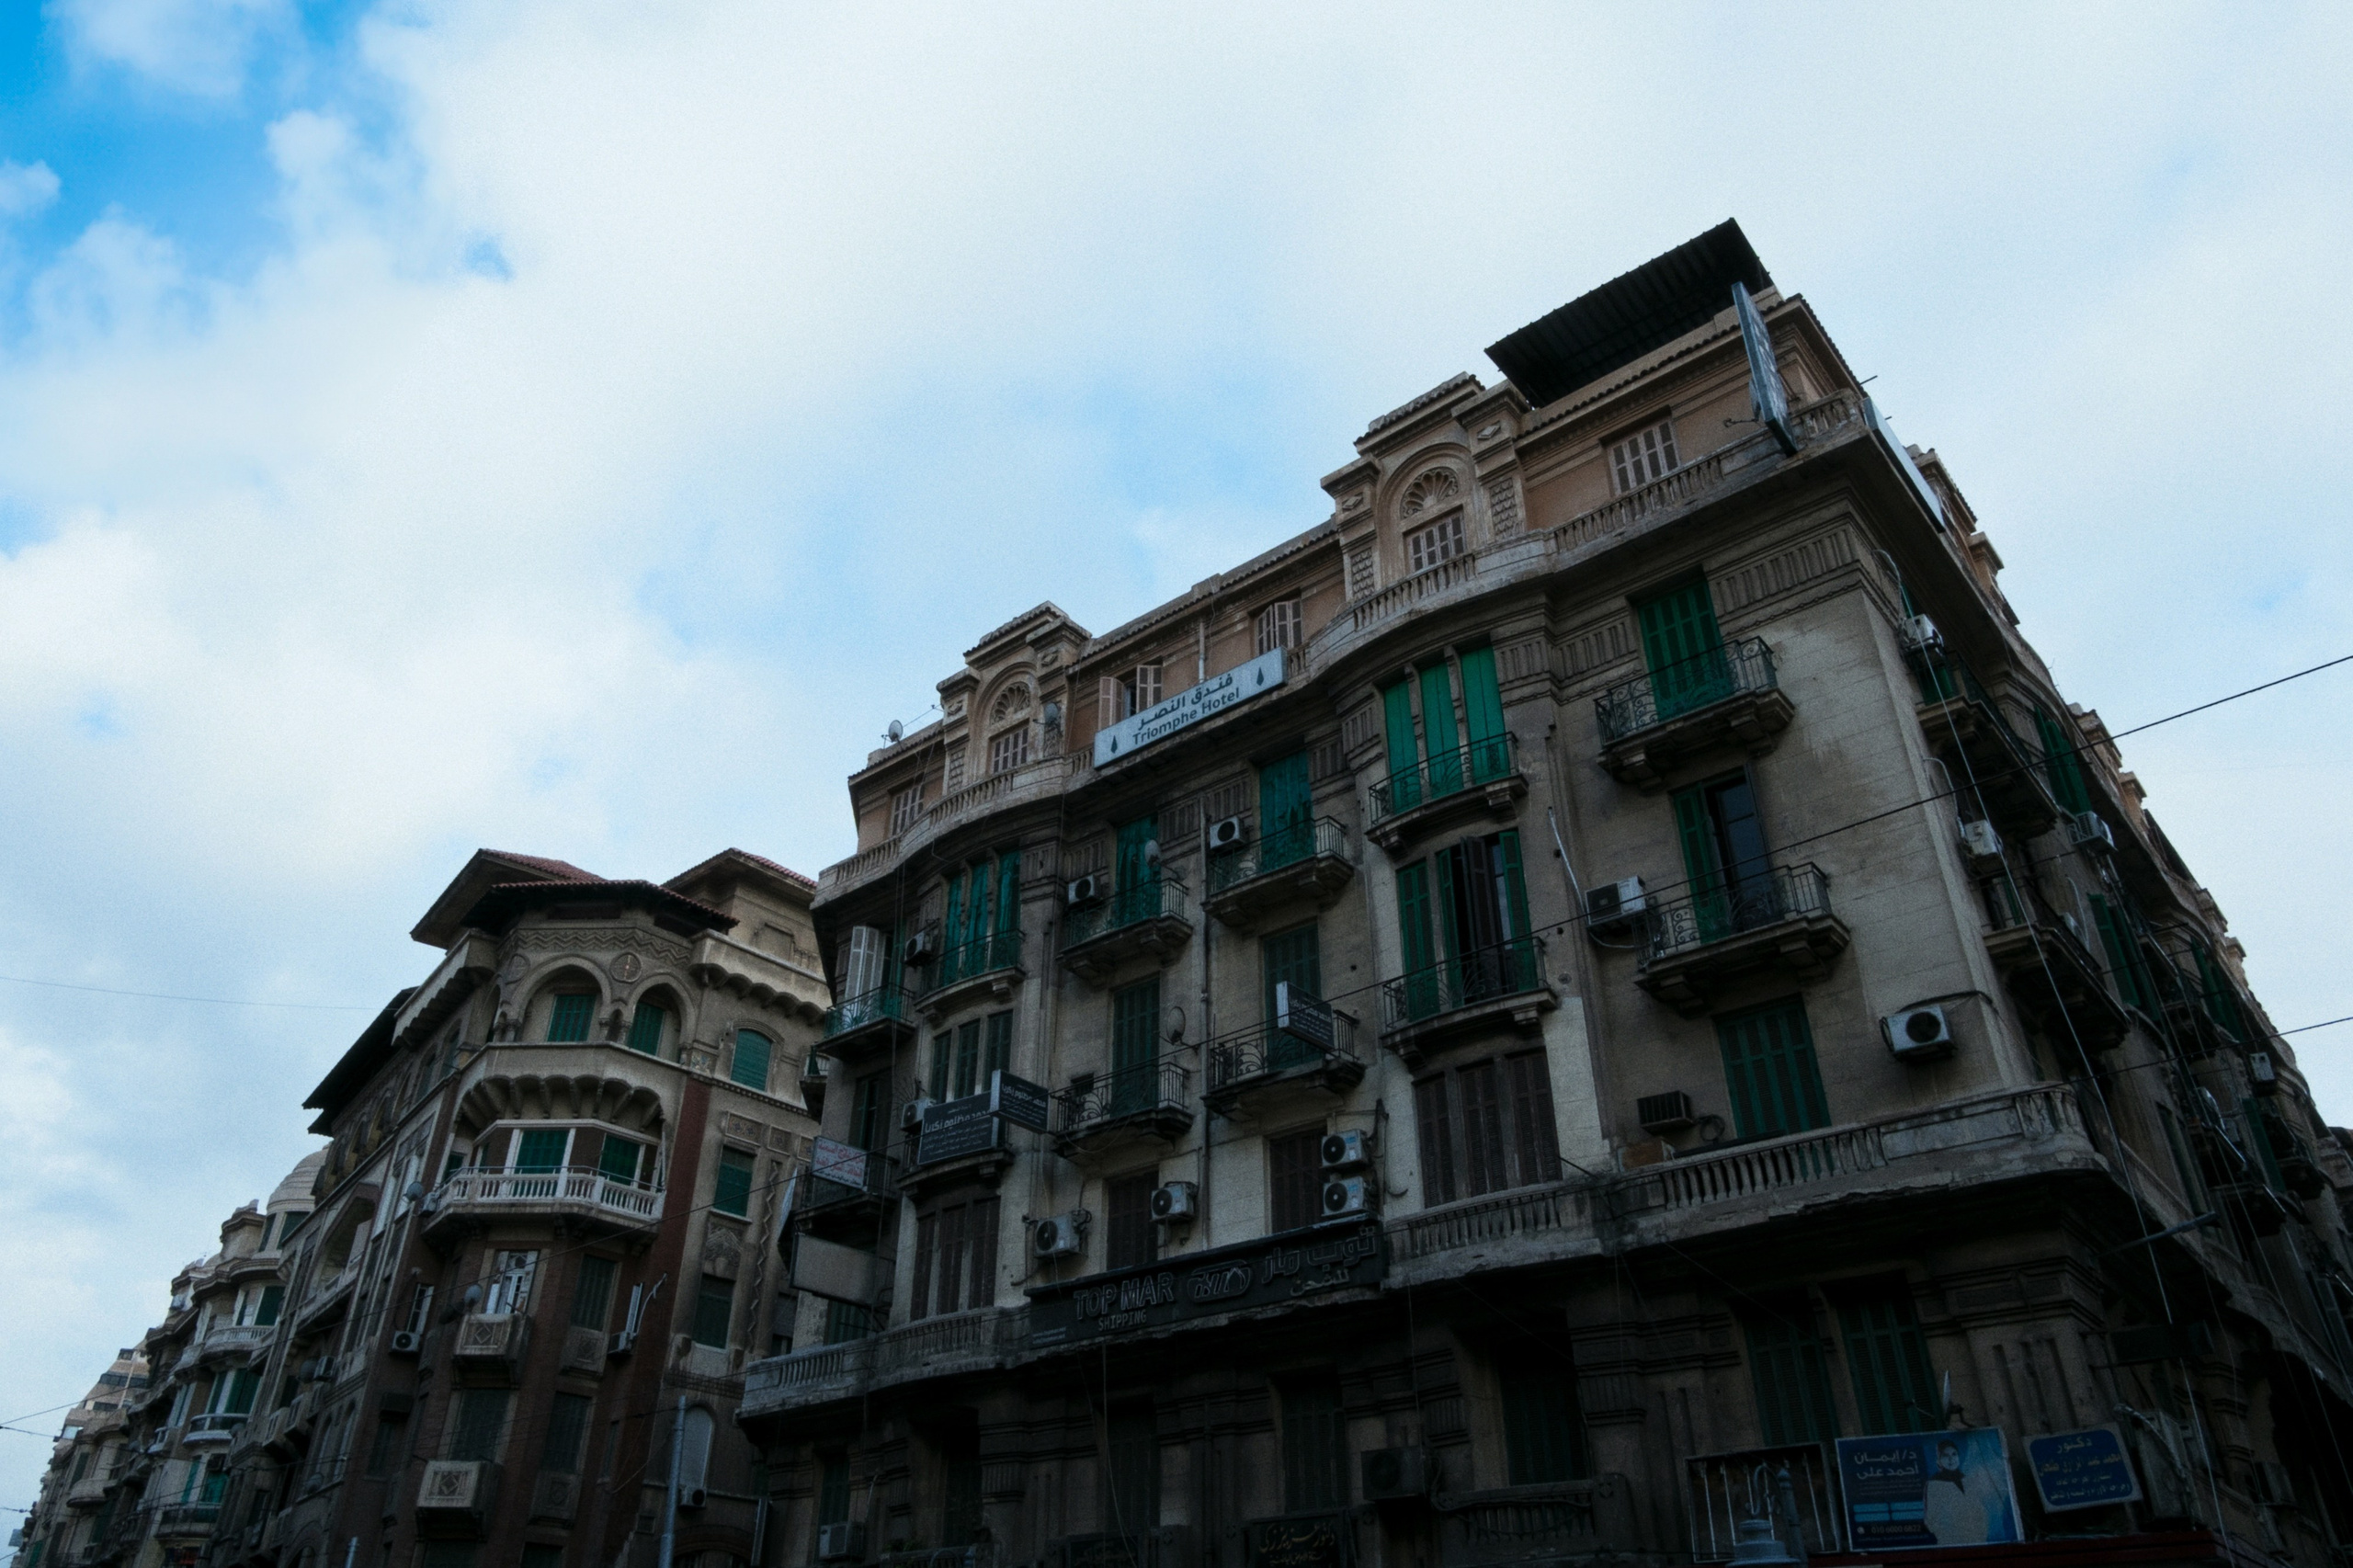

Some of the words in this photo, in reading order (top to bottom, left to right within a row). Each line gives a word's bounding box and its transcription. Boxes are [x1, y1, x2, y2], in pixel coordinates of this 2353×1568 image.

[1191, 673, 1233, 705] فندق
[1131, 709, 1198, 744] Triomphe
[1202, 687, 1240, 714] Hotel
[1138, 696, 1186, 731] النصر
[1261, 1246, 1301, 1284] مار
[1306, 1225, 1377, 1273] توب
[1073, 1283, 1118, 1320] TOP
[1120, 1271, 1176, 1312] MAR
[1290, 1268, 1350, 1297] للشحن
[1097, 1309, 1148, 1332] SHIPPING
[2056, 1436, 2094, 1455] دكتور
